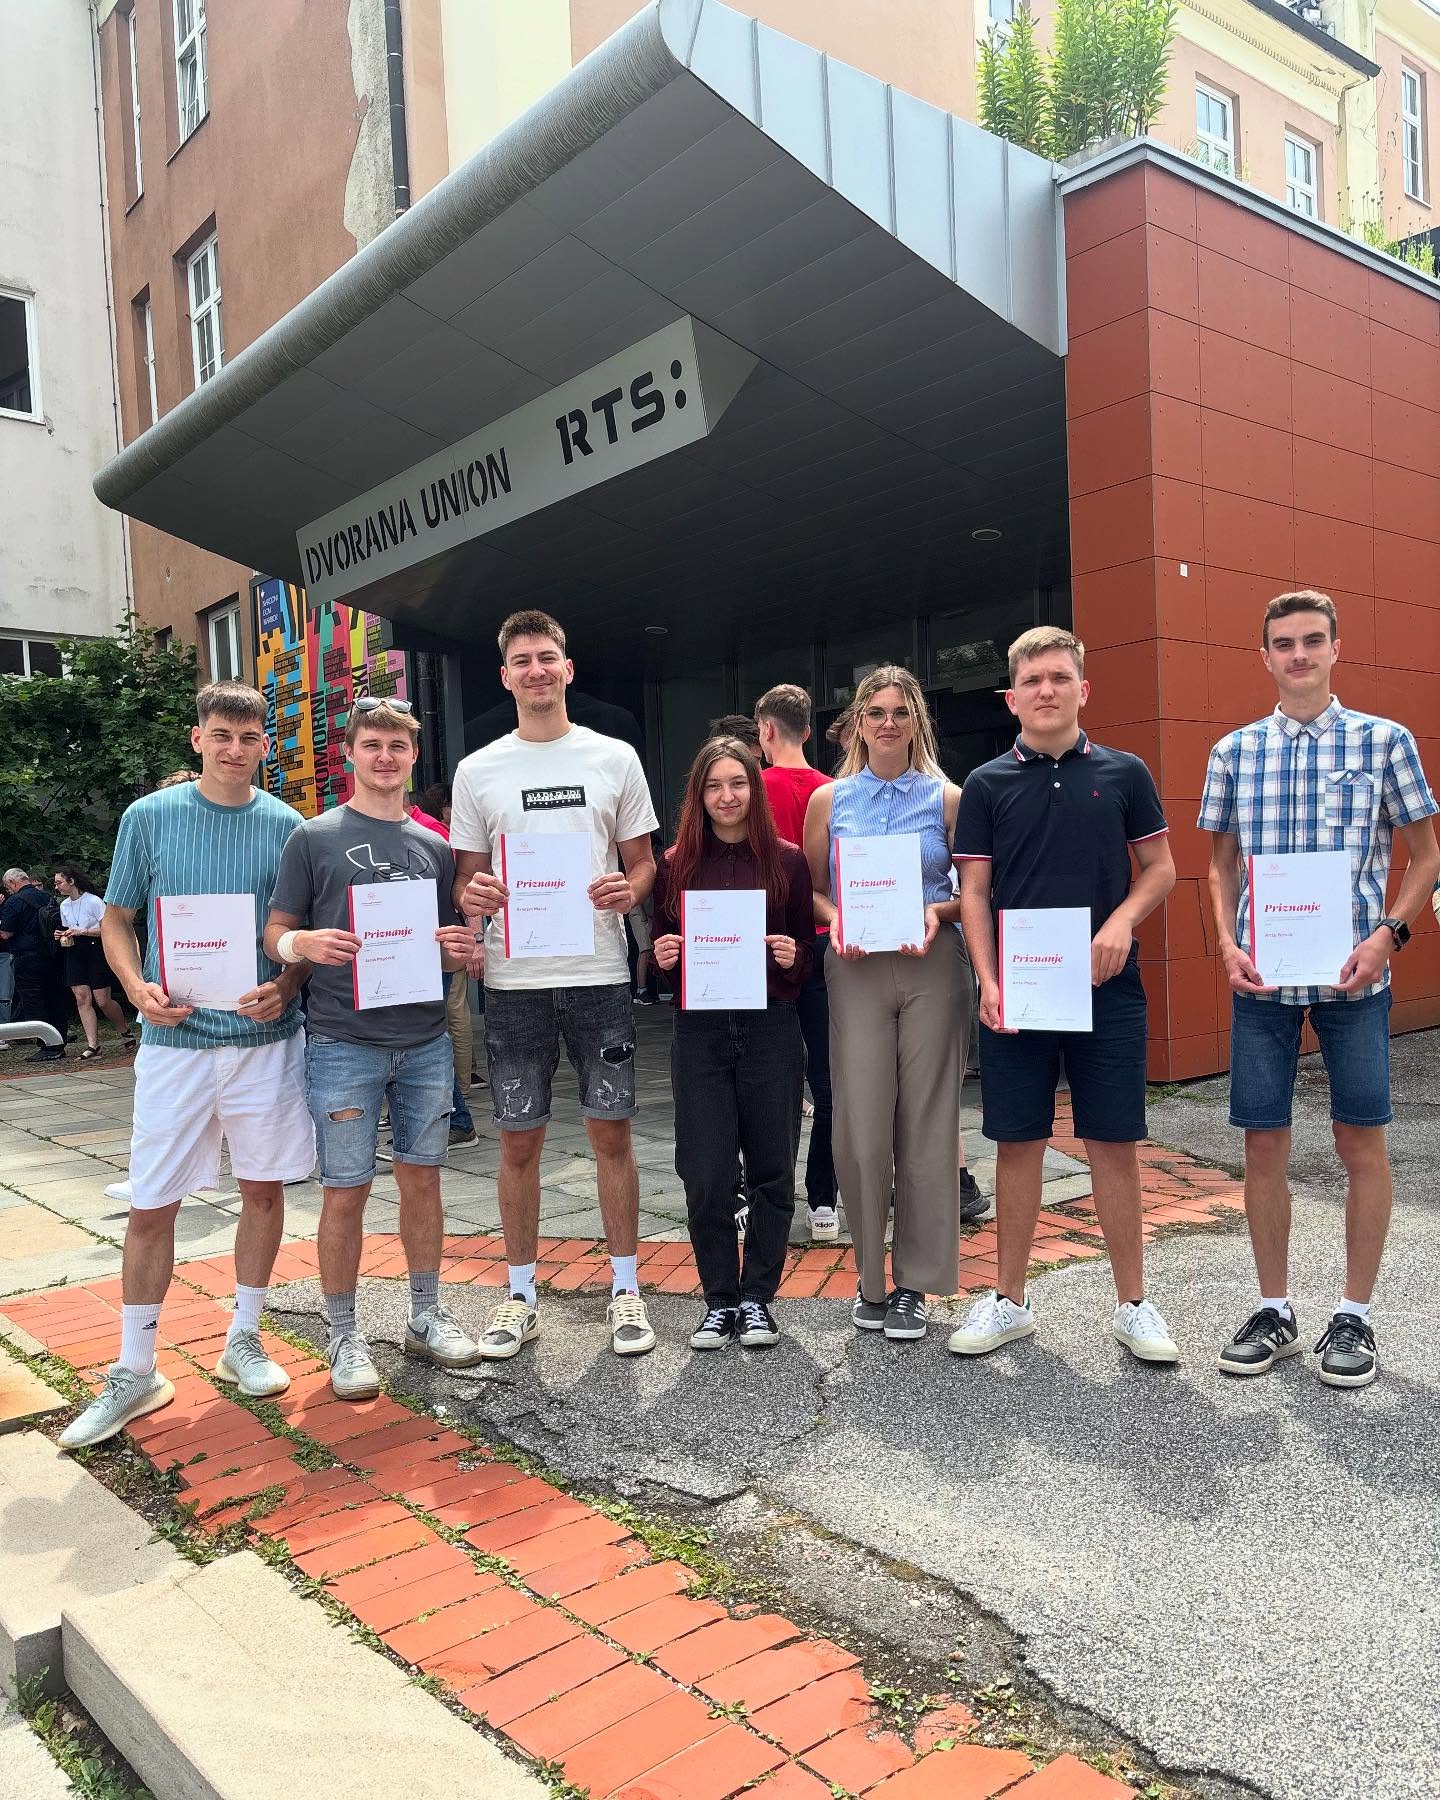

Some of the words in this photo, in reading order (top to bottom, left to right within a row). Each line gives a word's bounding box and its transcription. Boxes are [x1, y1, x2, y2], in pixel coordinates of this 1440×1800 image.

[305, 497, 418, 584] DVORANA
[420, 447, 512, 529] UNION
[310, 690, 331, 797] KOMORNI
[516, 878, 566, 889] Priznanje
[849, 877, 897, 888] Priznanje
[1264, 902, 1321, 914] Priznanje
[364, 926, 413, 939] Priznanje
[173, 938, 228, 949] Priznanje
[694, 933, 742, 944] Priznanje
[1012, 953, 1064, 964] Priznanje
[814, 1221, 835, 1229] adidas
